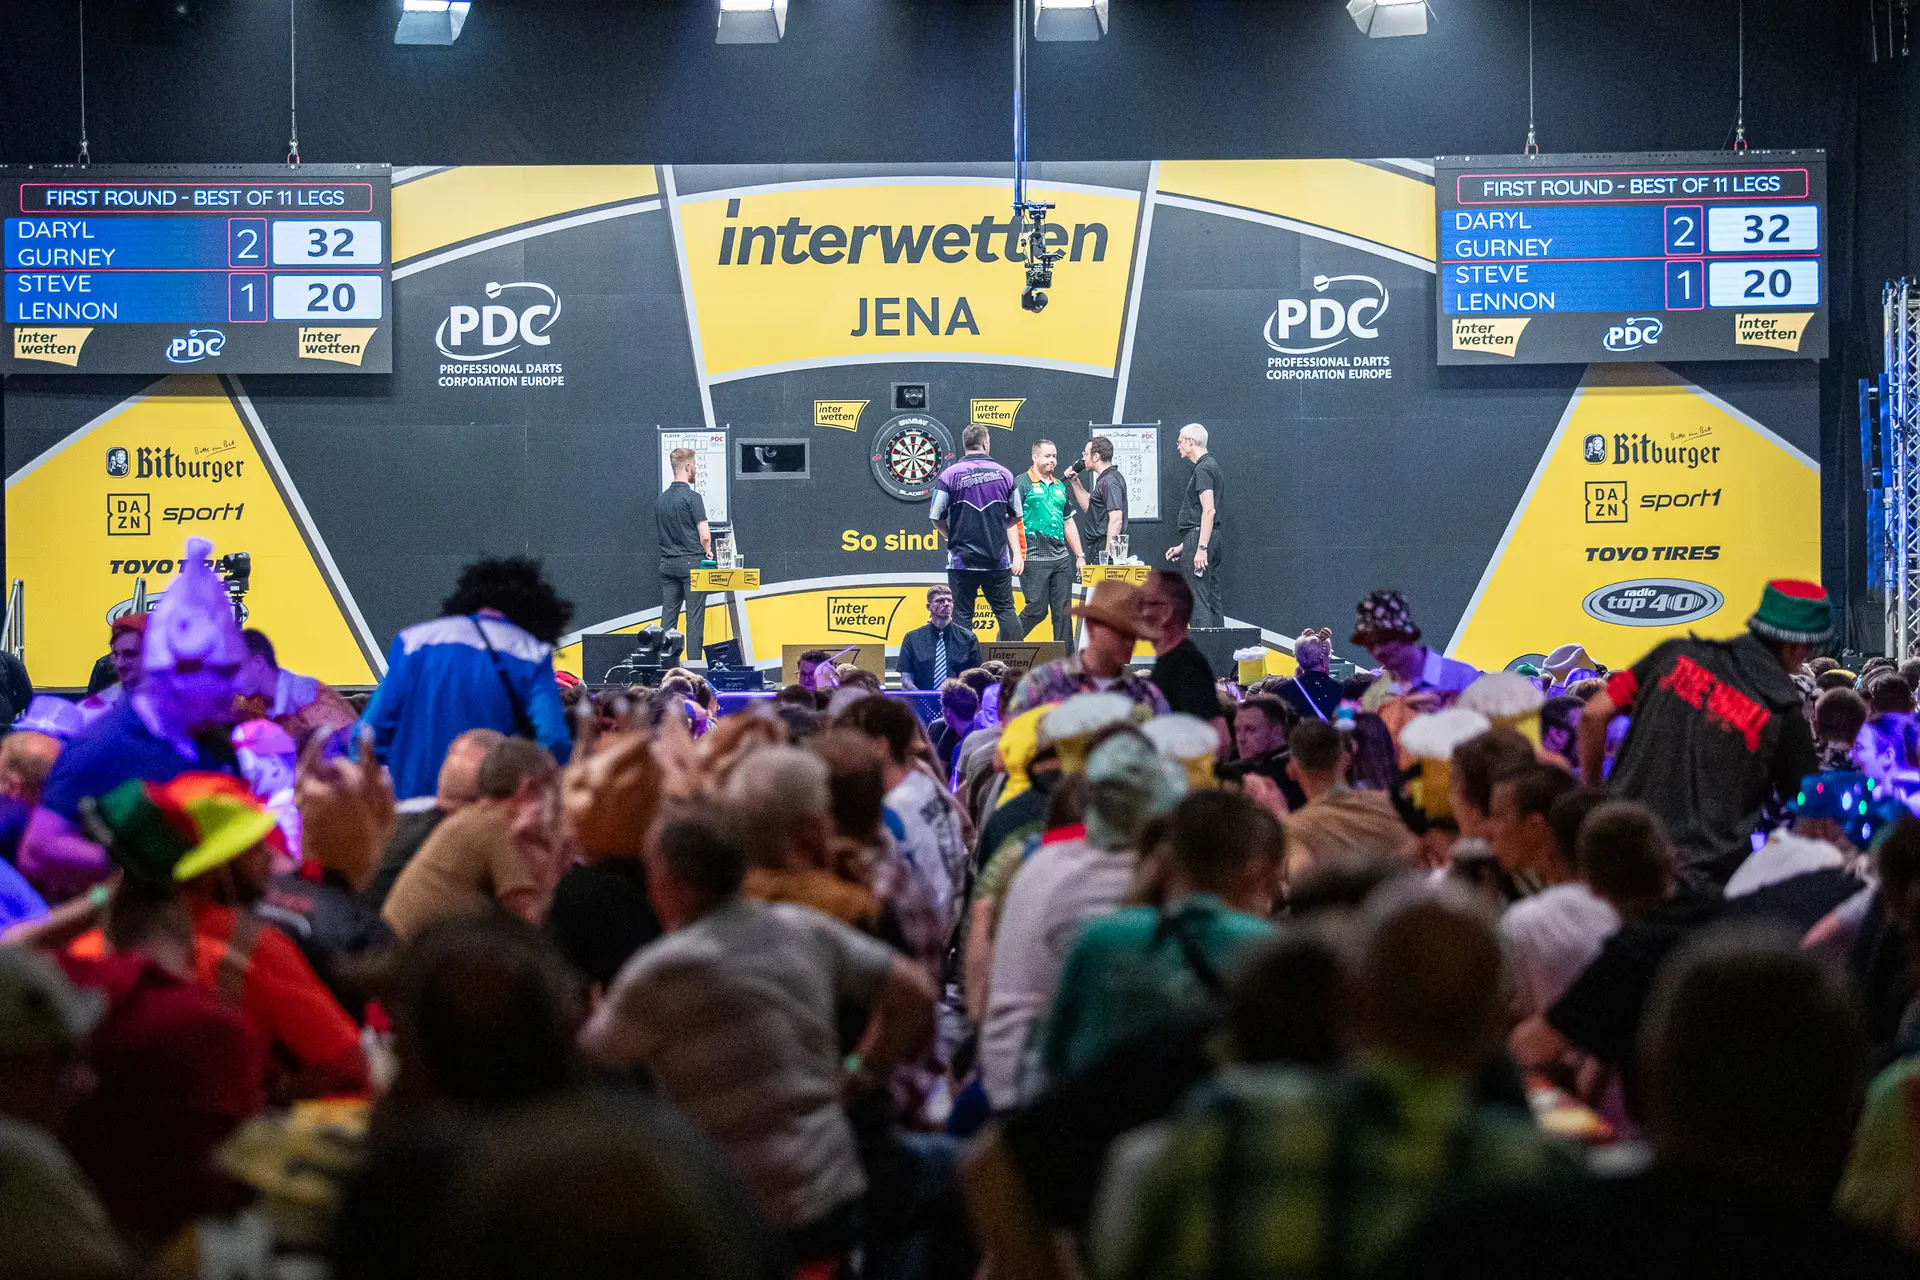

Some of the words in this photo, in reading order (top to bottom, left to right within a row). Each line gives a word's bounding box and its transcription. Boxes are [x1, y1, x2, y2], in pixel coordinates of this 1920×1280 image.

[1483, 181, 1537, 197] FIRST
[1541, 179, 1613, 195] ROUND
[1630, 178, 1677, 194] BEST
[1682, 177, 1708, 193] OF
[1713, 177, 1728, 192] 11
[1733, 176, 1781, 192] LEGS
[46, 190, 100, 206] FIRST
[104, 190, 176, 206] ROUND
[194, 190, 243, 206] BEST
[246, 190, 273, 206] OF
[277, 190, 292, 206] 11
[298, 190, 345, 206] LEGS
[18, 221, 94, 239] DARYL
[1456, 212, 1531, 231] DARYL
[1743, 214, 1791, 244] 32
[718, 198, 1108, 265] interwetten
[1673, 217, 1695, 246] 2
[237, 229, 259, 259] 2
[307, 228, 355, 257] 32
[1455, 238, 1553, 257] GURNEY
[18, 248, 116, 266] GURNEY
[1455, 265, 1528, 284] STEVE
[1744, 269, 1792, 298] 20
[18, 275, 91, 293] STEVE
[1677, 271, 1690, 299] 1
[240, 283, 253, 312] 1
[307, 283, 356, 312] 20
[1456, 292, 1555, 311] LENNON
[19, 302, 118, 320] LENNON
[850, 296, 981, 337] JENA
[1278, 297, 1379, 339] PDC
[450, 304, 551, 346] PDC
[1456, 319, 1495, 335] inter
[1739, 314, 1778, 330] inter
[17, 328, 57, 344] inter
[301, 328, 342, 344] inter
[1459, 334, 1514, 346] wetten
[1609, 325, 1659, 345] PDC
[1742, 328, 1797, 341] wetten
[20, 343, 76, 355] wetten
[172, 337, 221, 357] PDC
[305, 343, 360, 355] wetten
[440, 364, 523, 375] PROFESSIONAL
[526, 363, 562, 374] DARTS
[1268, 357, 1350, 368] PROFESSIONAL
[1353, 356, 1390, 367] DARTS
[438, 376, 518, 387] CORPORATION
[521, 376, 564, 387] EUROPE
[1266, 369, 1345, 380] CORPORATION
[1349, 369, 1392, 379] EUROPE
[818, 402, 842, 413] inter
[975, 401, 999, 412] inter
[977, 411, 1011, 420] wetten
[820, 412, 855, 421] wetten
[1612, 432, 1721, 469] Bitburger
[135, 446, 245, 483] Bitburger
[1640, 489, 1722, 512] sport1
[162, 503, 245, 525] sport1
[841, 529, 877, 551] So
[884, 529, 939, 551] sind
[1585, 547, 1648, 562] TOYO
[1651, 545, 1721, 561] TIRES
[110, 559, 174, 574] TOYO
[1624, 587, 1656, 597] radio
[832, 598, 868, 614] inter
[1607, 595, 1647, 613] top
[1649, 593, 1699, 612] 40
[835, 615, 886, 625] wetten
[973, 620, 995, 630] 023
[992, 648, 1016, 659] inter
[1004, 659, 1029, 668] etten
